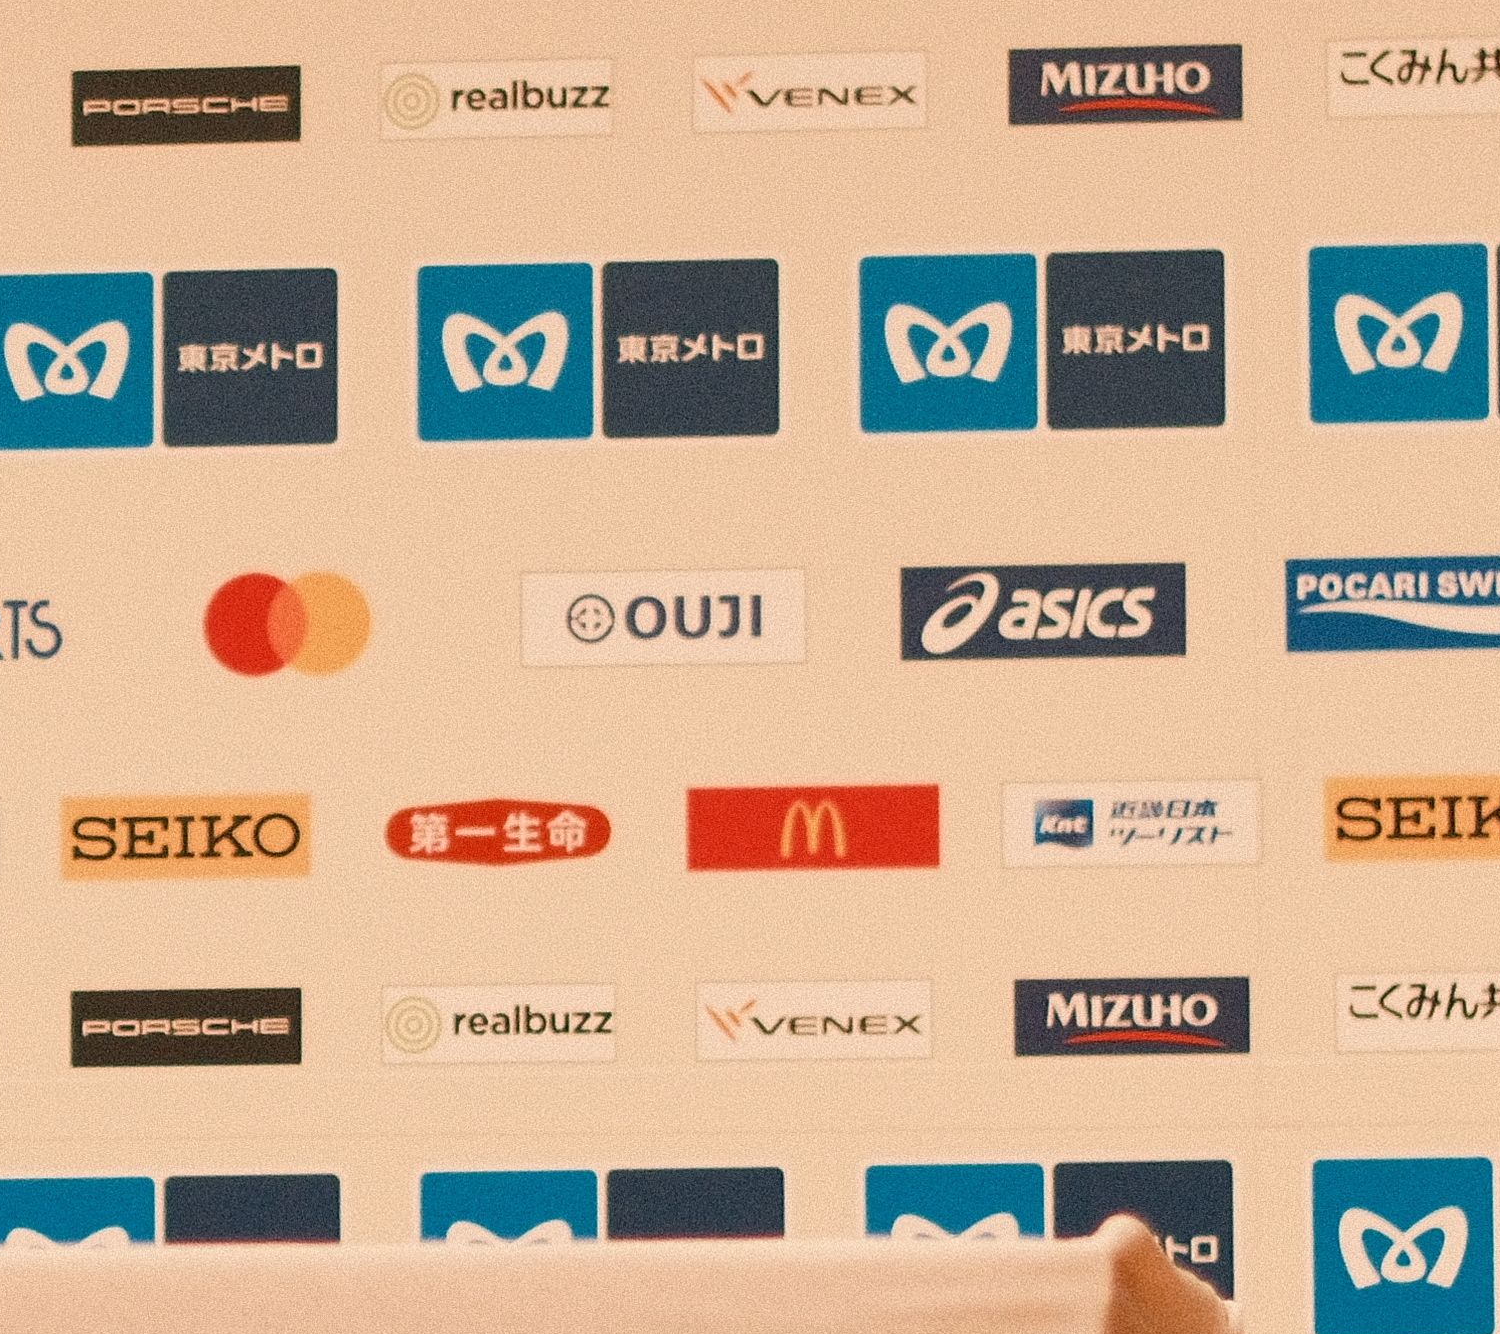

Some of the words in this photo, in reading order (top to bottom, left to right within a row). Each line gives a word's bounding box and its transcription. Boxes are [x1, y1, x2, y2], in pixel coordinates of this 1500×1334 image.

[1042, 63, 1210, 95] MIZUHO
[452, 81, 609, 111] realbuzz
[748, 87, 914, 107] VENEX
[619, 334, 764, 363] 東京メトロ
[1298, 573, 1434, 604] POCARI
[625, 595, 761, 639] OUJI
[999, 588, 1155, 639] asics
[72, 813, 300, 861] SEIKO
[410, 810, 587, 854] 第一生命
[454, 1005, 612, 1035] realbuzz
[752, 1016, 919, 1035] VENEX
[1047, 993, 1217, 1027] MIZUHO
